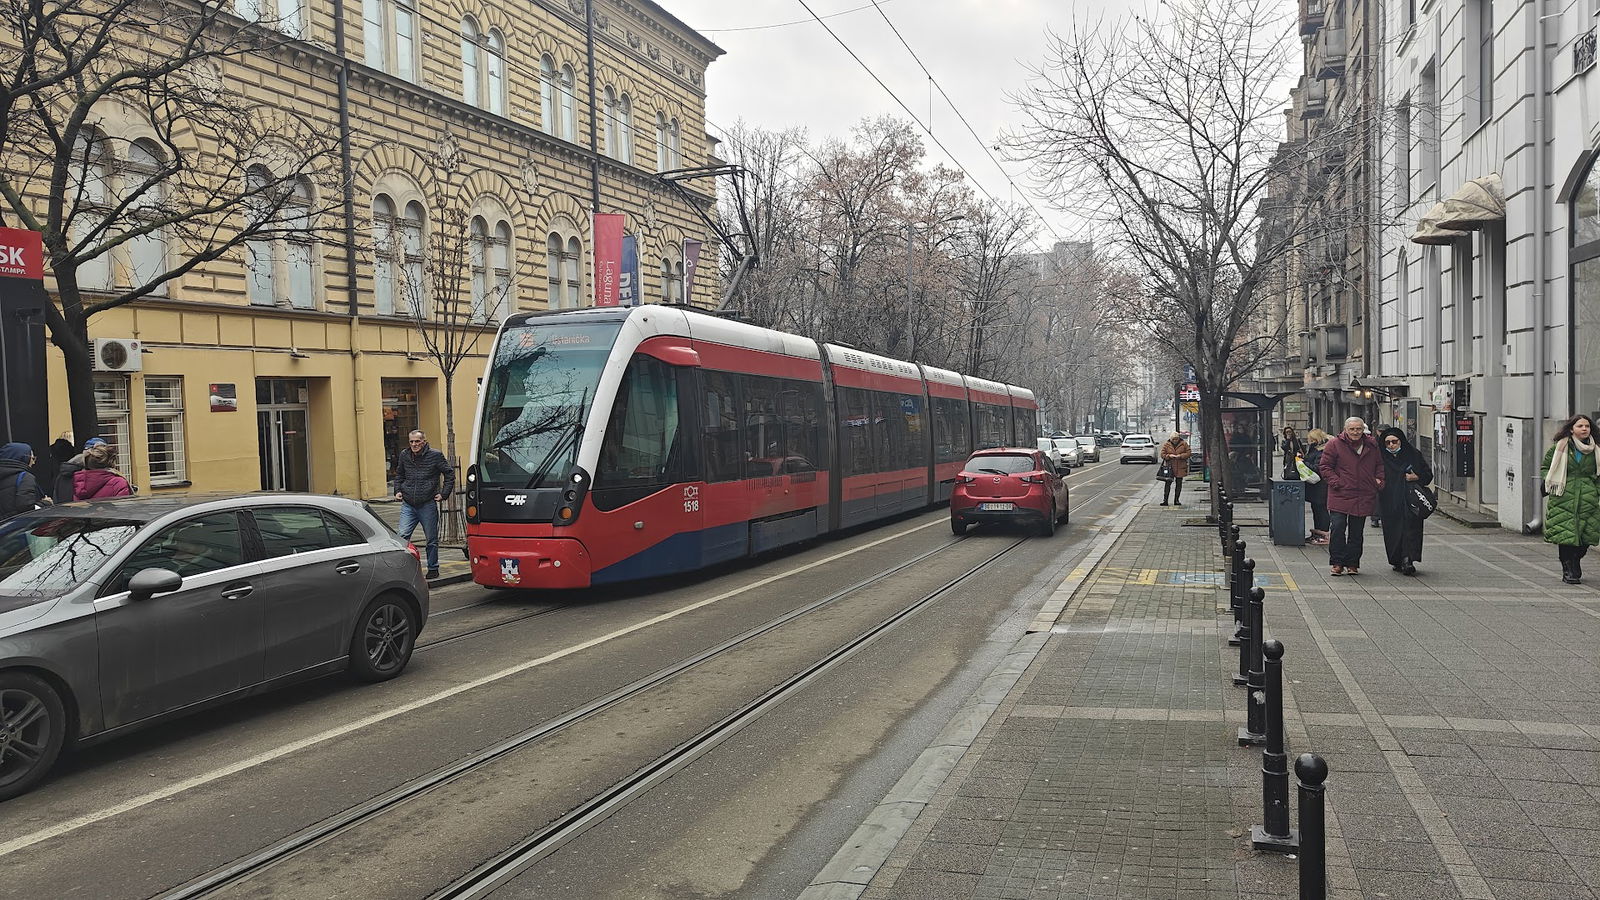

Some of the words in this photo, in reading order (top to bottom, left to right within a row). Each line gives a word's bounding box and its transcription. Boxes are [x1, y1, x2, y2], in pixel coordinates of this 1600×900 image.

[0, 266, 26, 275] TAMPA
[603, 261, 615, 304] Laguna
[505, 495, 527, 505] CAF
[684, 500, 698, 512] 1518
[1414, 489, 1433, 511] adidas
